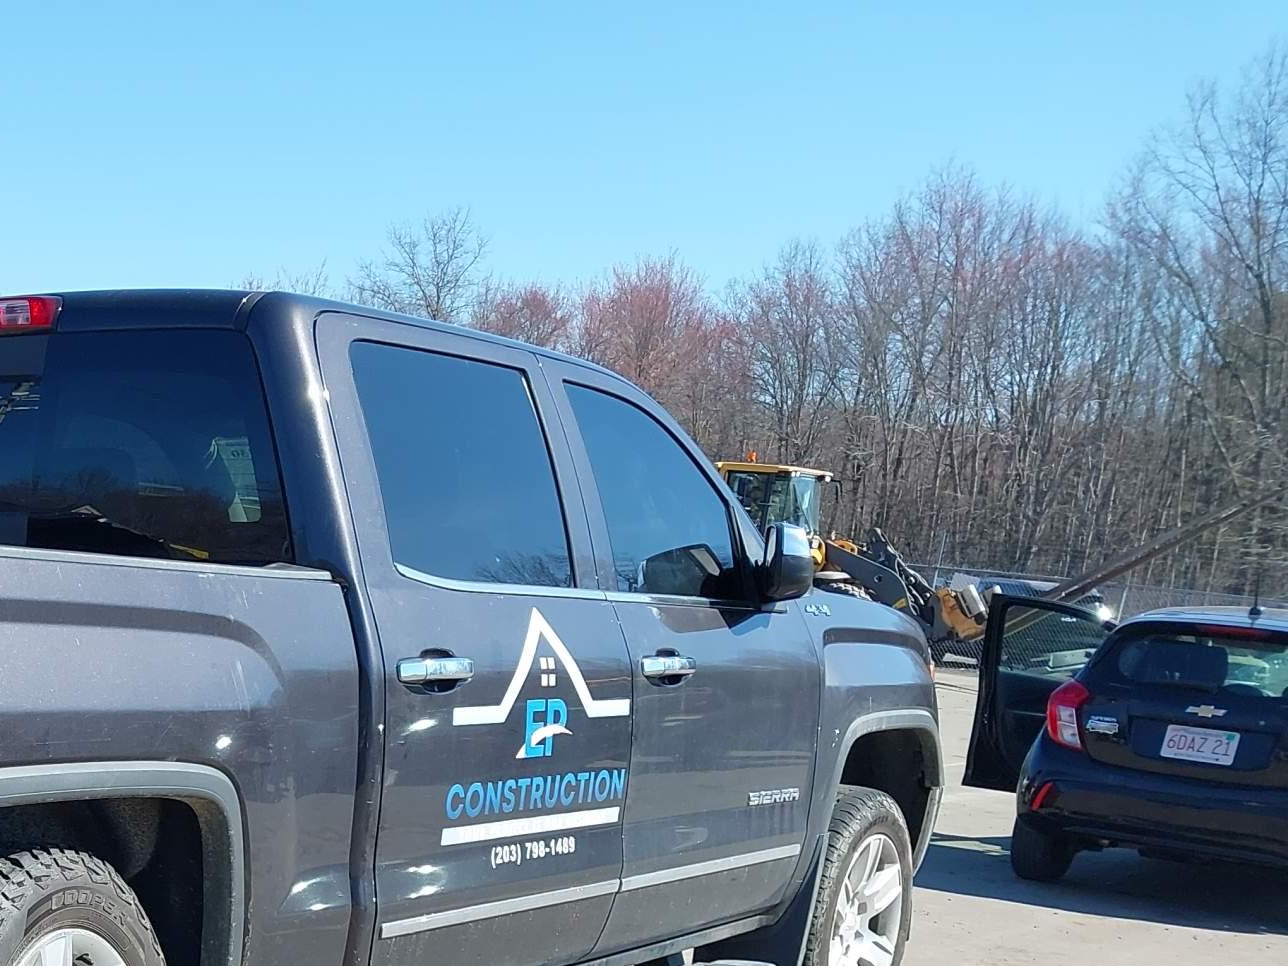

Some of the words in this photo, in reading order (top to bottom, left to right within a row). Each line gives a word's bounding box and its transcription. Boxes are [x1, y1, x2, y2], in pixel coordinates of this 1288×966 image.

[523, 697, 569, 759] EP
[1167, 733, 1208, 753] 6DAZ
[1211, 739, 1230, 756] 21
[445, 768, 628, 821] CONSTRUCTION
[748, 787, 800, 806] SIERRA
[491, 843, 522, 869] (203)
[525, 836, 576, 859] 798-1489
